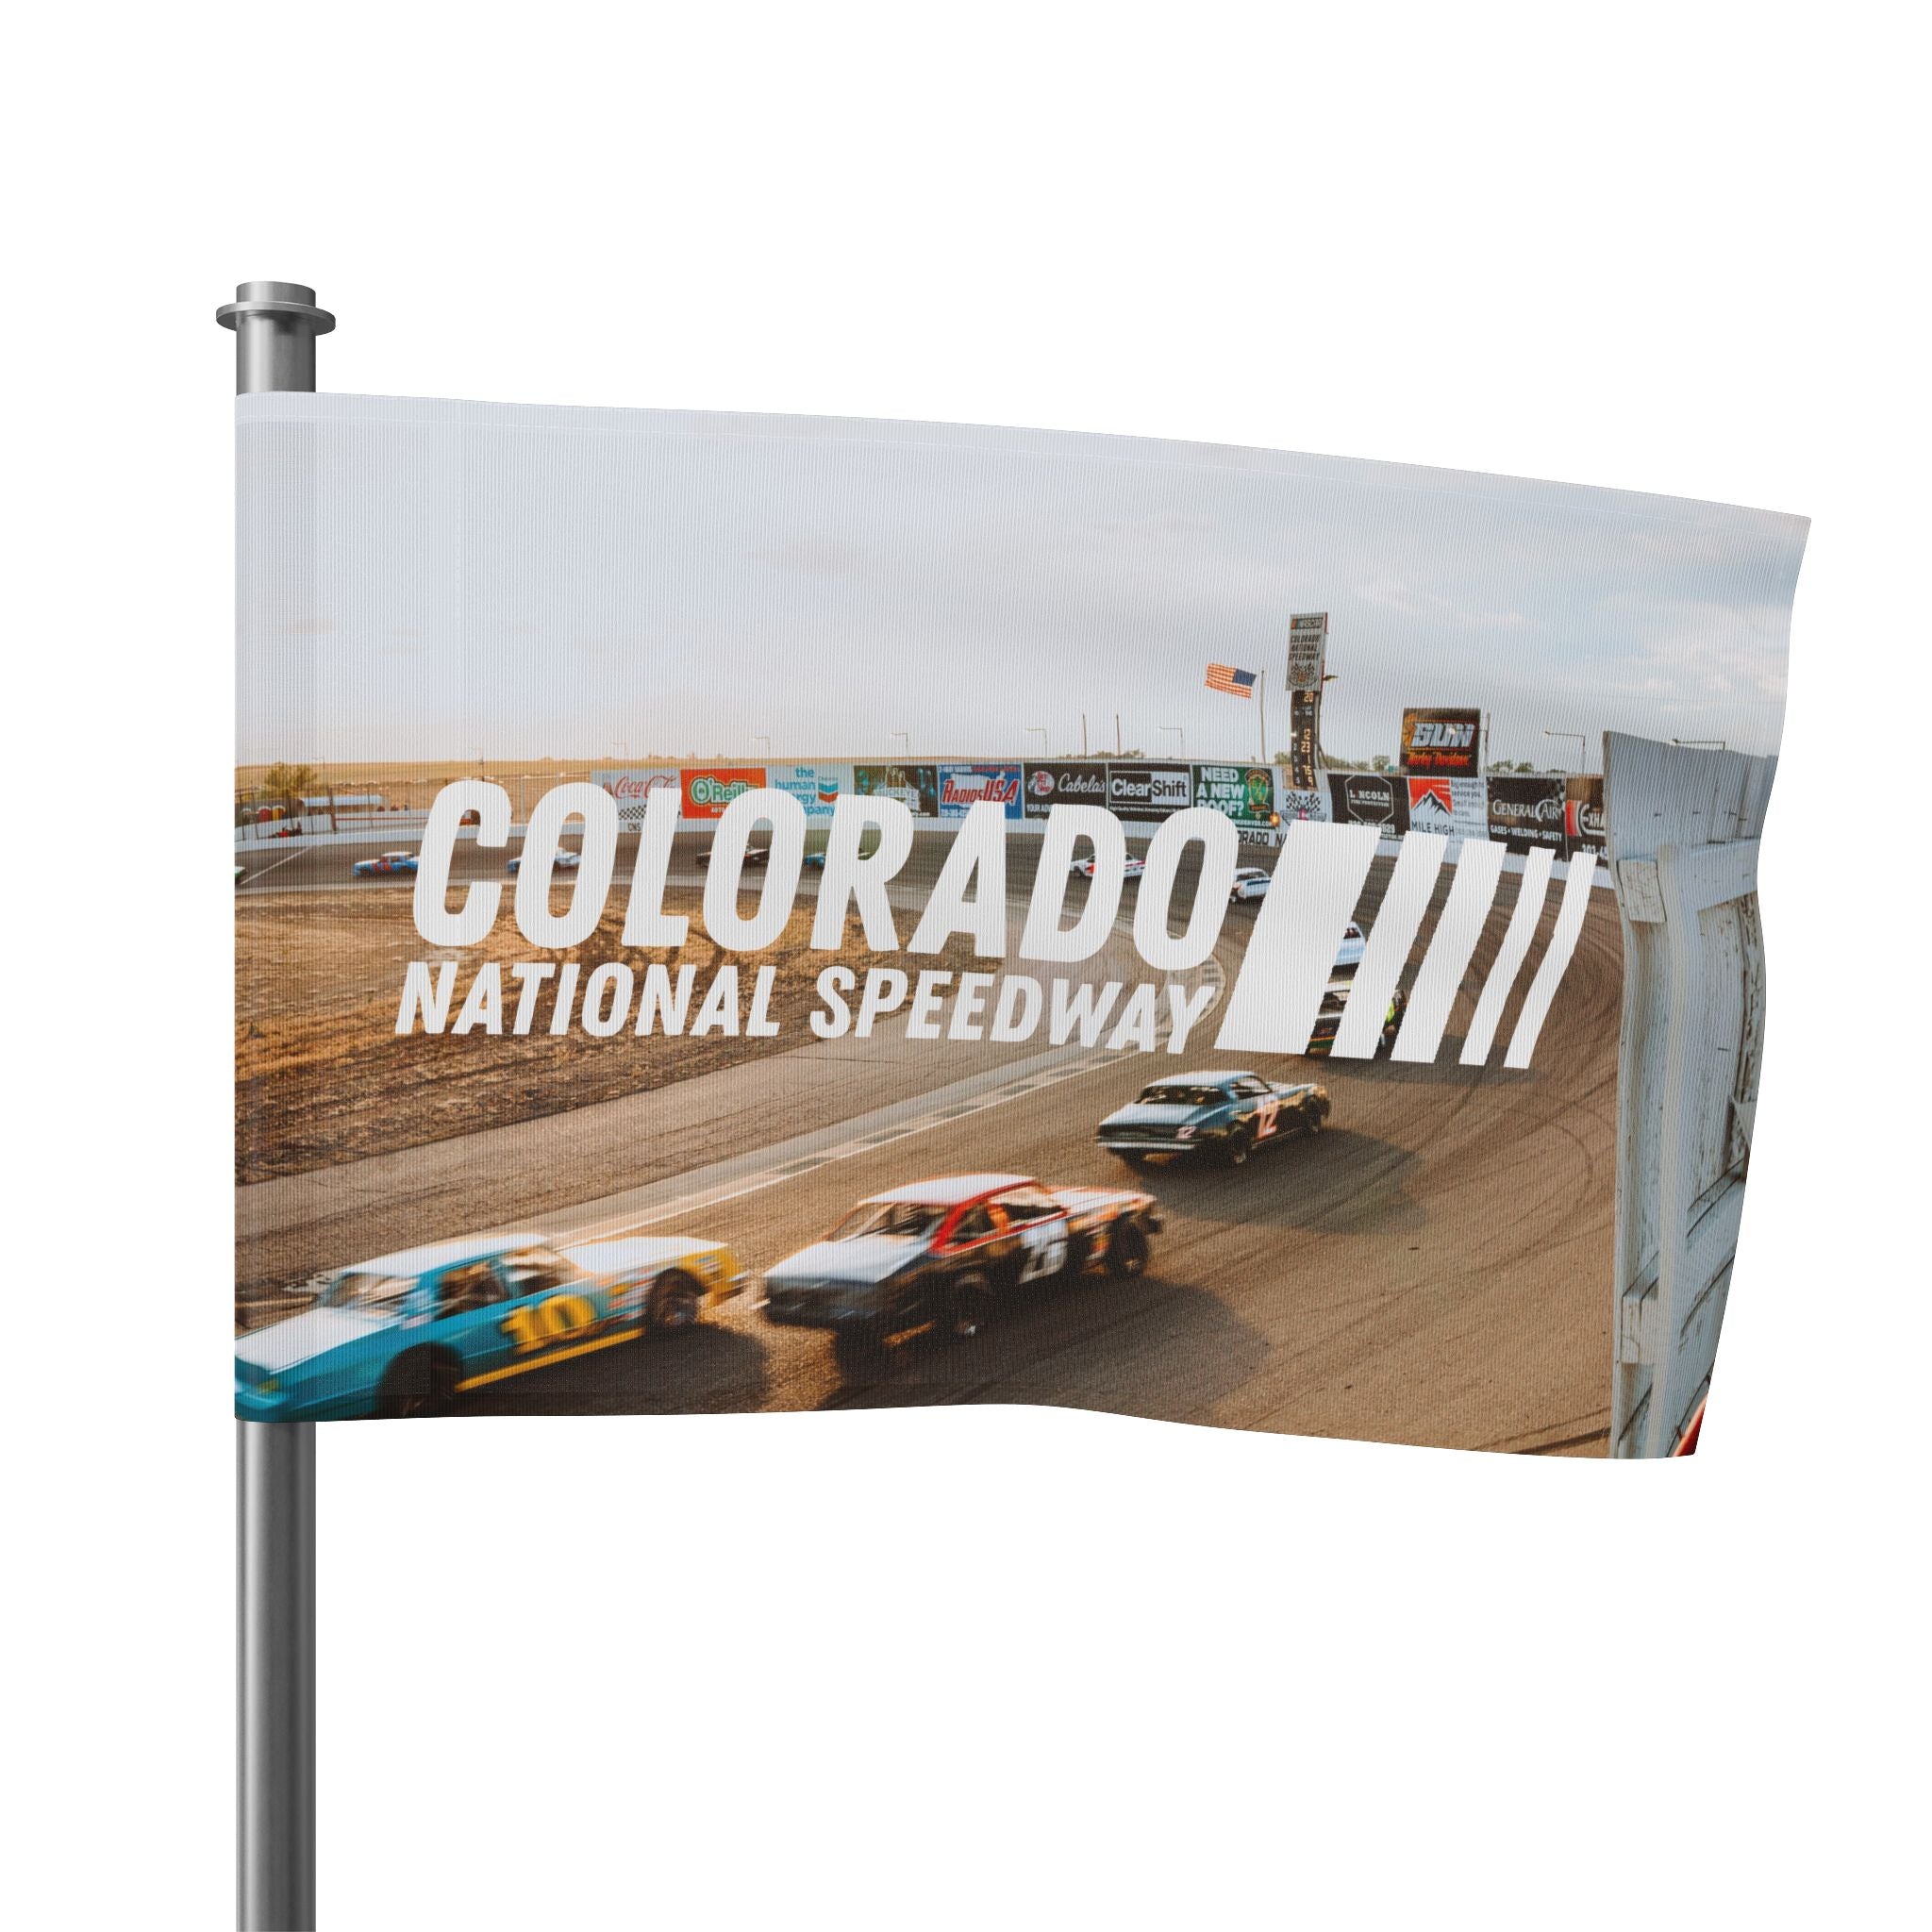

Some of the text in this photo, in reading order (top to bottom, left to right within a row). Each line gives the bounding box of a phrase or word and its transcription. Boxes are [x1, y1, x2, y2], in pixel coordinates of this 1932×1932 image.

[1410, 722, 1475, 747] SUN
[795, 767, 815, 777] the
[1201, 767, 1240, 783] NEED
[774, 779, 816, 790] human
[1058, 773, 1106, 793] Cabela's
[1196, 782, 1245, 800] A NEW
[1349, 790, 1390, 801] LNCOLN
[1411, 821, 1432, 833] MILE
[1434, 823, 1455, 837] HIGH
[1542, 830, 1562, 841] SAFETY
[412, 779, 1239, 971] COLORADO
[395, 960, 1217, 1054] NATIONAL SPEEDWAY
[500, 1292, 597, 1355] 10
